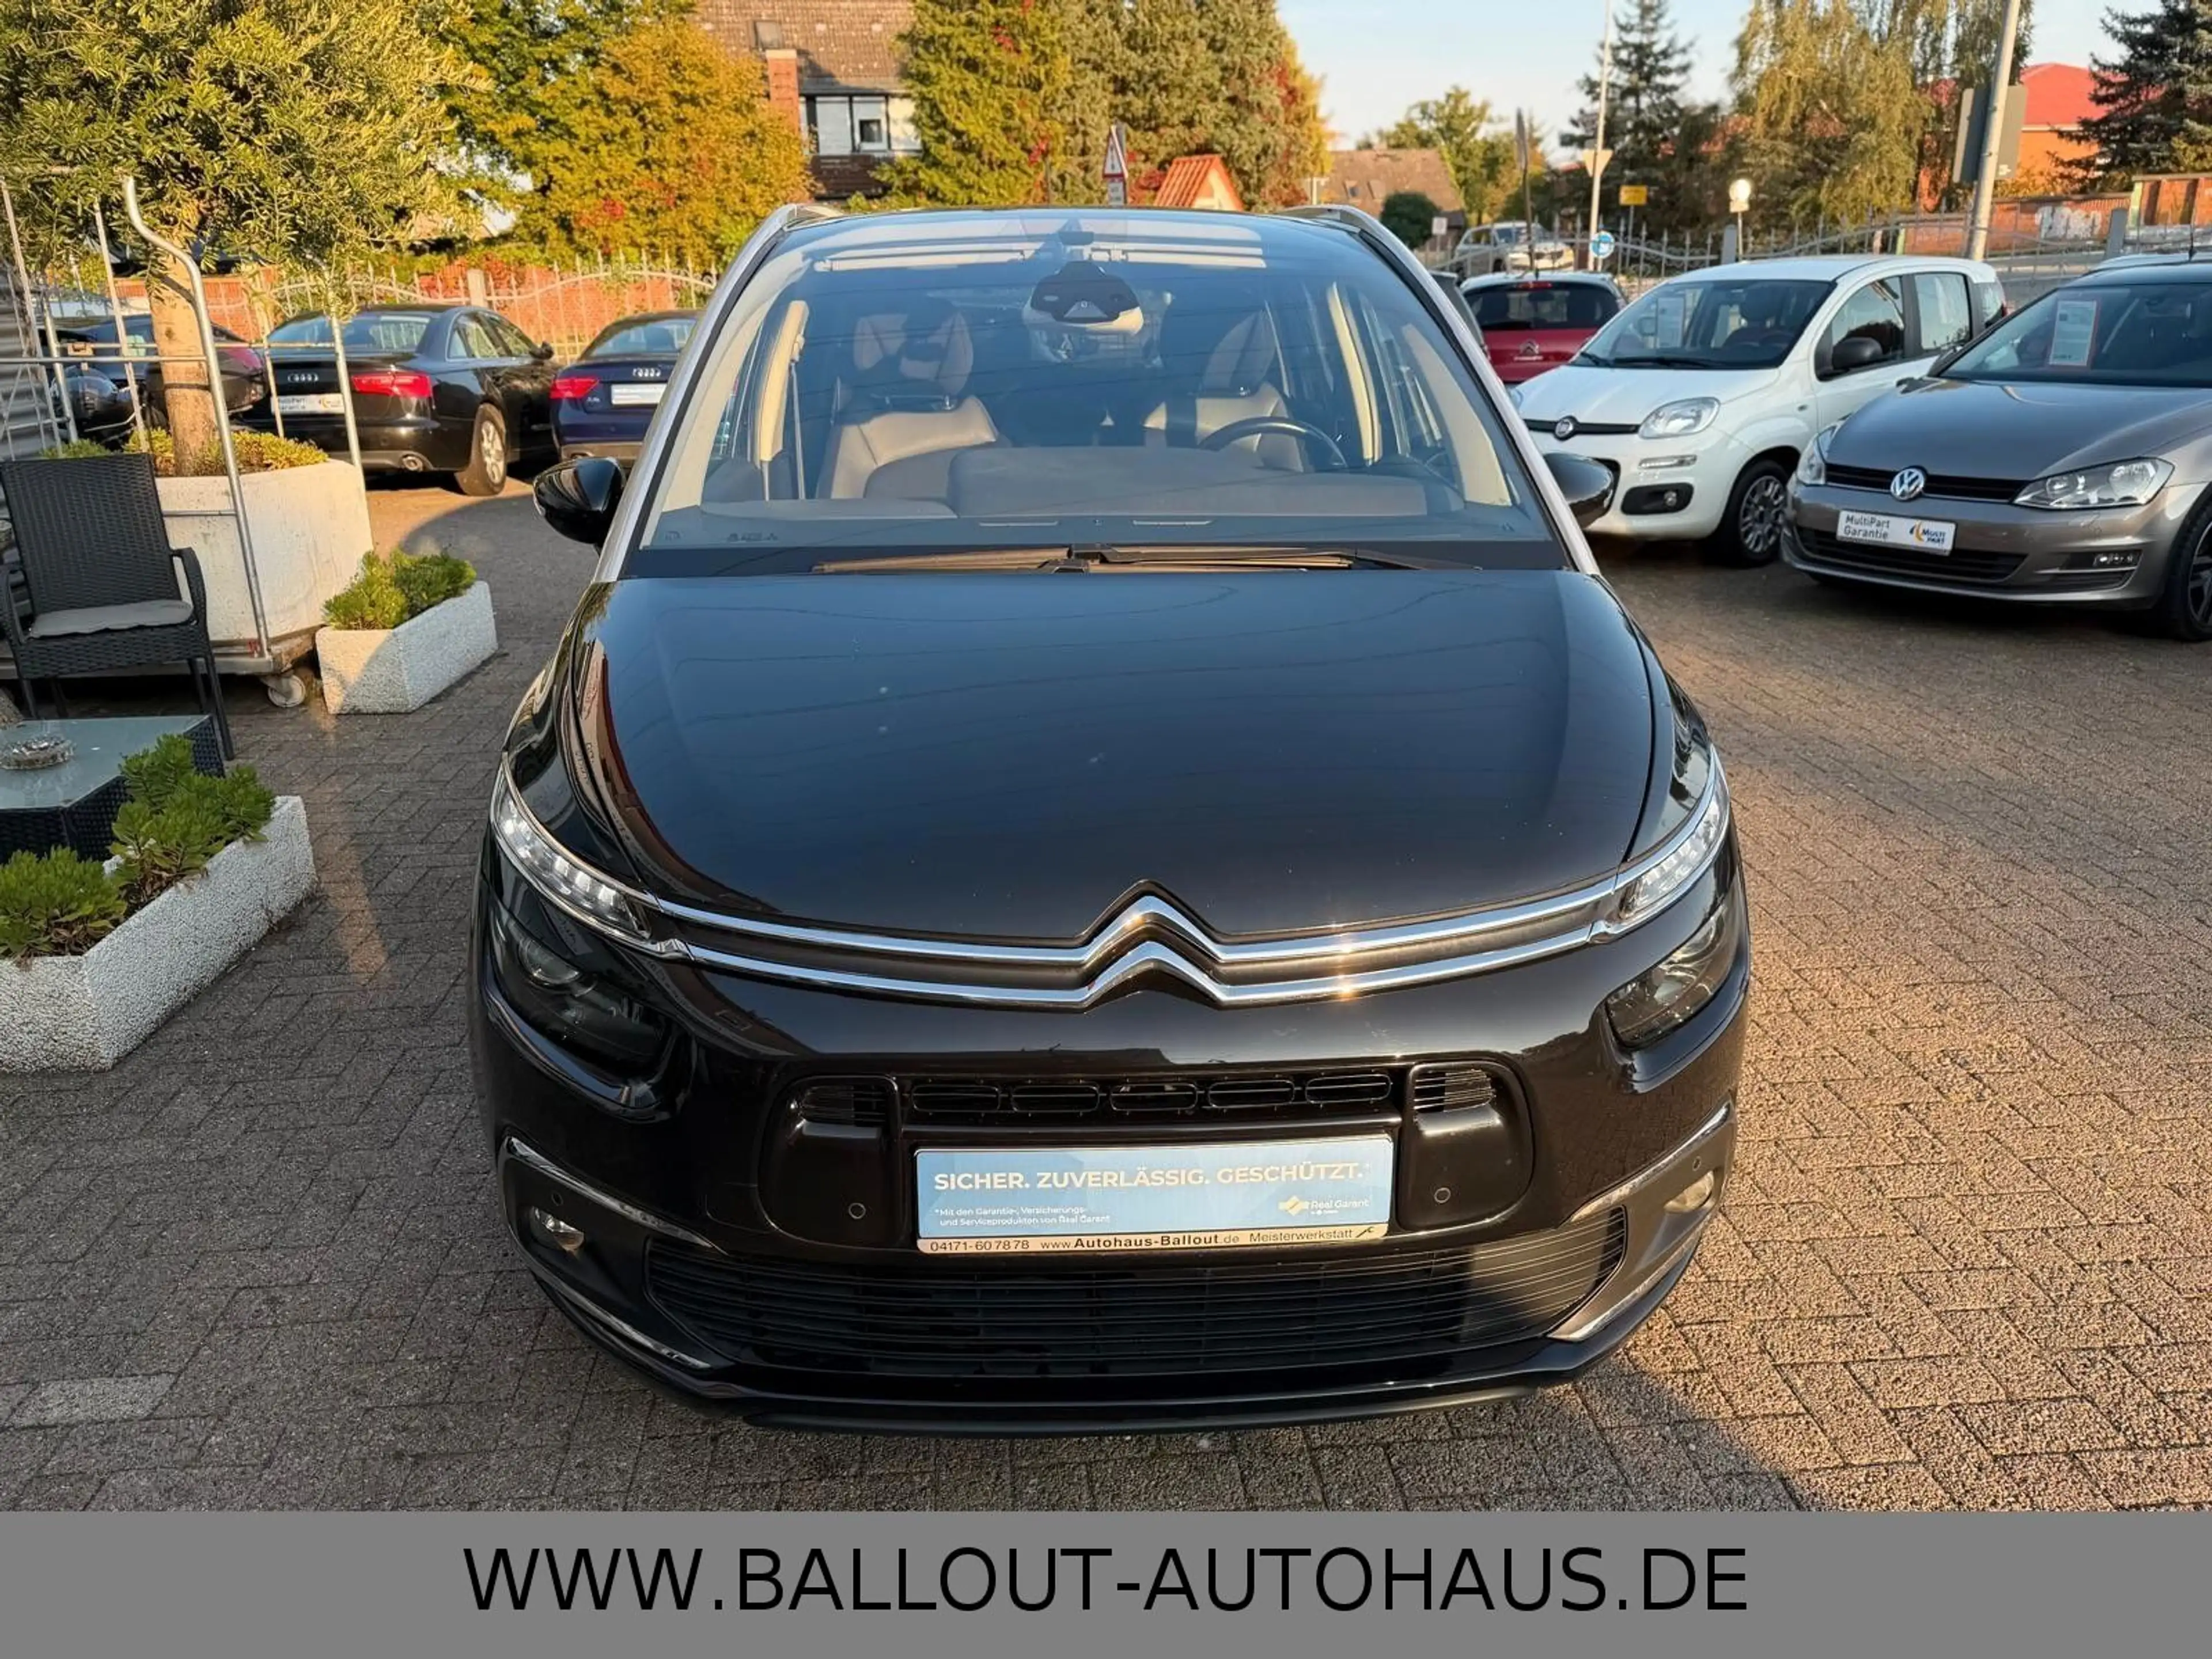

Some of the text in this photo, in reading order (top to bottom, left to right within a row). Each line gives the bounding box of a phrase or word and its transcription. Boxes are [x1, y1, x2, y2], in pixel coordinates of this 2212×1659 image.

[1845, 514, 1891, 529] MultiPart
[1843, 525, 1889, 539] Garantie
[934, 1172, 1031, 1191] SICHER.
[1036, 1166, 1210, 1189] ZUVERLÄSSIG.
[940, 1217, 958, 1226] und
[1040, 1234, 1240, 1249] www.Autohaus-Ballout.de
[1249, 1228, 1353, 1243] Meisterwerkstatt
